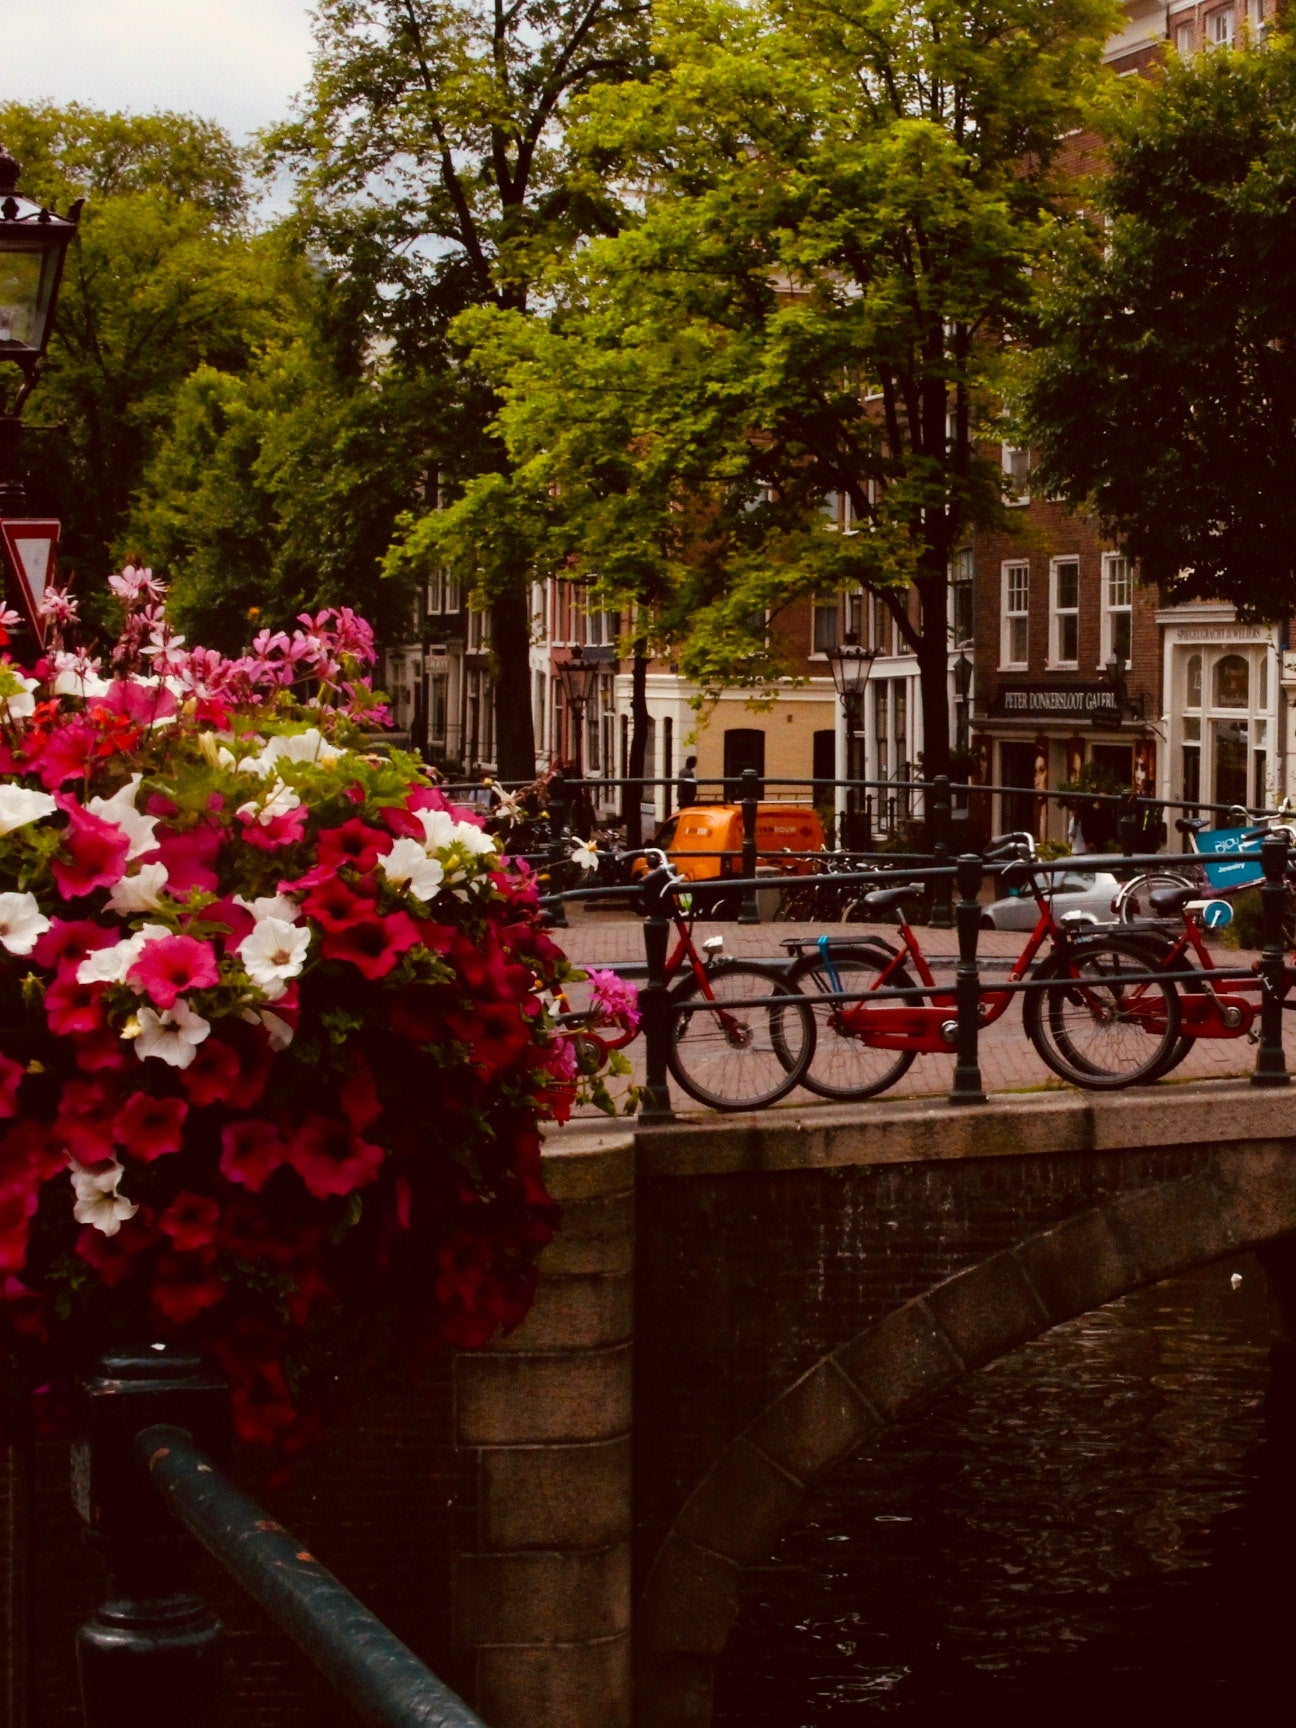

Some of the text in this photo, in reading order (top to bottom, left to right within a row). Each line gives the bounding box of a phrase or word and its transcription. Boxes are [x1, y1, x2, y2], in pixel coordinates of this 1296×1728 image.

[1004, 692, 1028, 709] PETER
[1029, 692, 1084, 710] DONKERSLOOT
[1217, 862, 1246, 873] Jewelry
